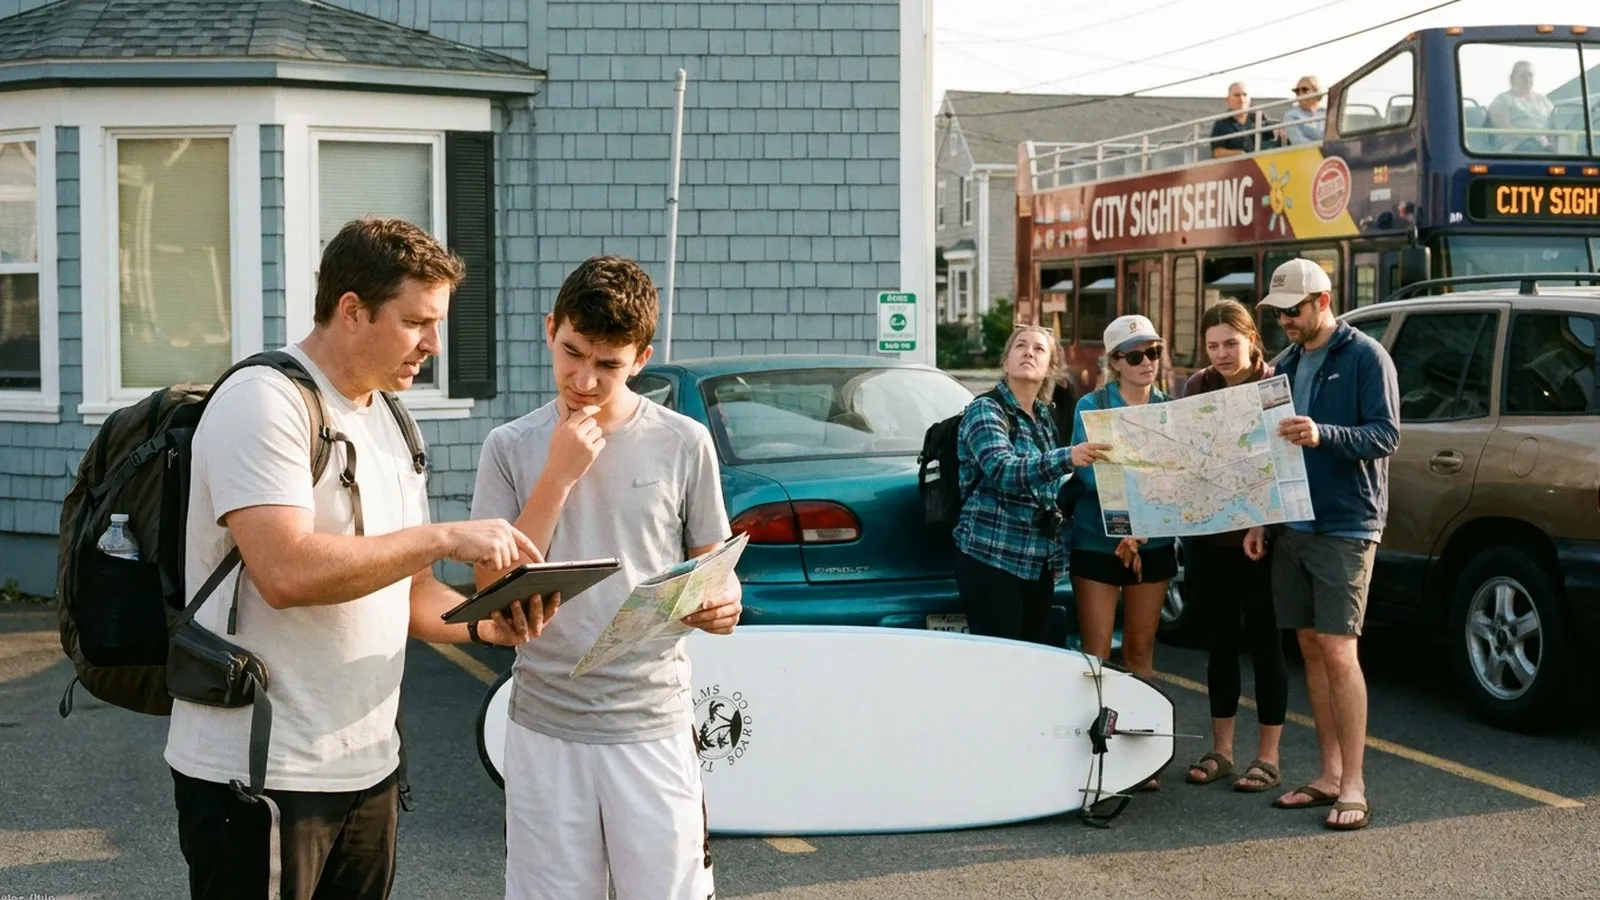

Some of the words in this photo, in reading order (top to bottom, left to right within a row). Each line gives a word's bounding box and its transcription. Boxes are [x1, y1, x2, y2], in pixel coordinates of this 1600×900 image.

[1091, 193, 1128, 241] CITY
[1130, 175, 1254, 238] SIGHTSEEING
[1496, 185, 1544, 214] CITY
[1549, 186, 1600, 215] SIGH
